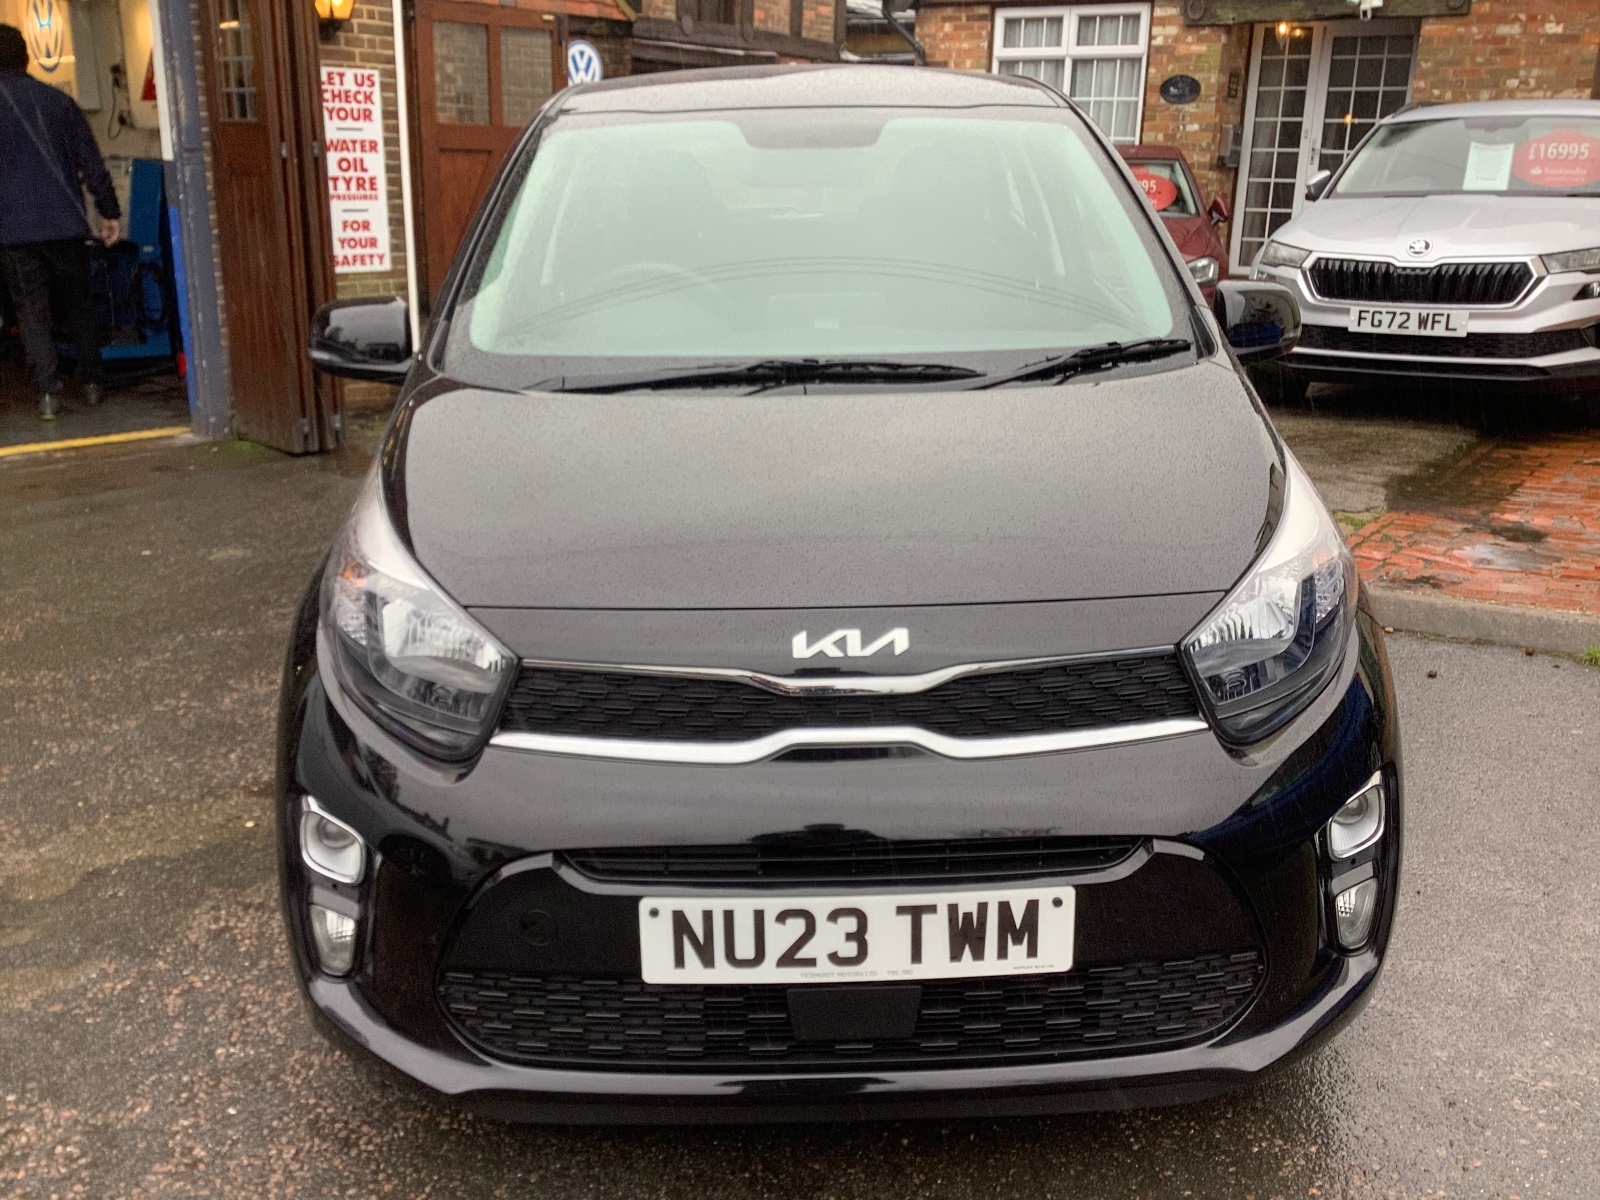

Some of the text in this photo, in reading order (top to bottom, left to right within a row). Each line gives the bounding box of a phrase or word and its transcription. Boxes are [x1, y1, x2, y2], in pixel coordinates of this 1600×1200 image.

[354, 73, 375, 87] US
[321, 89, 375, 105] CHECK
[325, 107, 373, 122] YOUR
[325, 139, 378, 153] WATER
[1529, 142, 1590, 160] £16995
[337, 157, 368, 172] OIL
[328, 176, 377, 191] TYRE
[342, 220, 370, 232] FOR
[338, 237, 378, 249] YOUR
[333, 254, 385, 267] SAFETY
[1357, 309, 1458, 332] FG72 WFL
[792, 627, 909, 658] KIA
[671, 899, 1040, 970] NU23 TWM
